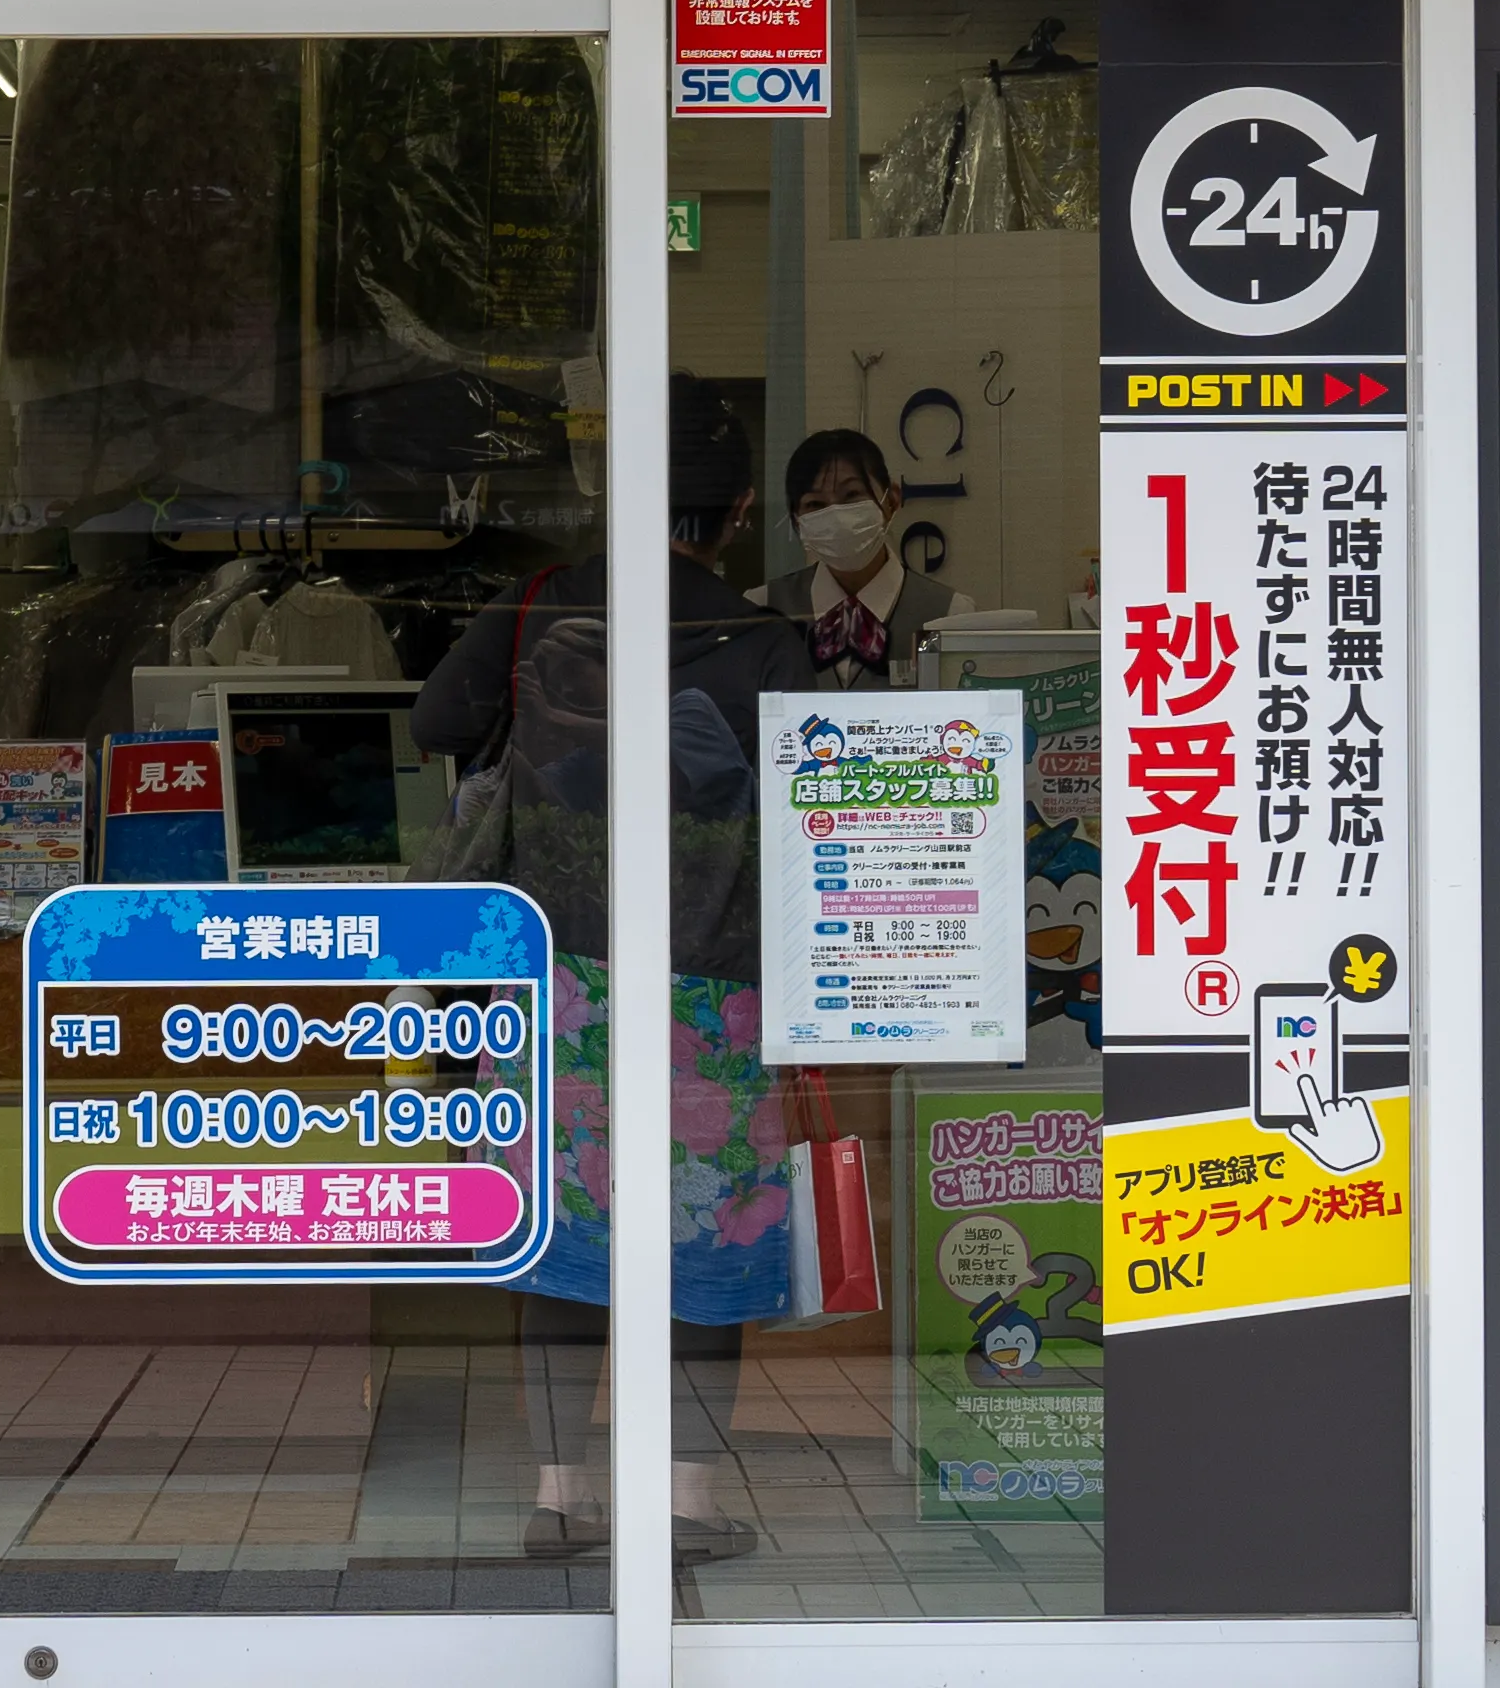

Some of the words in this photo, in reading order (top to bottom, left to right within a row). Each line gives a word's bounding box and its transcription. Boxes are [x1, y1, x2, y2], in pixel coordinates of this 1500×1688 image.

[695, 10, 800, 26] 設置しております。
[681, 50, 738, 58] EMERGENCY
[740, 50, 774, 58] SIGNAL
[776, 50, 786, 58] IN
[788, 50, 822, 58] EFFECT
[682, 68, 820, 103] SECOM
[1127, 374, 1251, 408] POST
[1260, 374, 1303, 408] IN
[135, 760, 208, 794] 見本
[842, 764, 947, 777] パート・アルバイト
[849, 845, 864, 854] 当店
[854, 921, 873, 931] 平日
[891, 921, 914, 930] 9:00
[936, 920, 966, 930] 20:00
[854, 932, 874, 942] 日祝
[886, 932, 914, 941] 10:00
[937, 931, 966, 941] 19:00
[197, 915, 379, 960] 営業時間
[52, 1017, 118, 1056] 平日
[50, 1102, 118, 1143] 日祝
[1115, 1151, 1286, 1201] アプリ登録で
[126, 1174, 304, 1216] 毎週木曜
[321, 1174, 450, 1216] 定休日
[1122, 1180, 1403, 1246] 「オンライン決済」
[126, 1220, 452, 1243] および年末年始、お盆期間休業
[964, 1227, 1002, 1241] 当店の
[950, 1242, 1015, 1256] ハンガーに
[957, 1258, 1008, 1271] 限らせて
[1127, 1251, 1206, 1295] OK!
[948, 1273, 1018, 1286] いただきます
